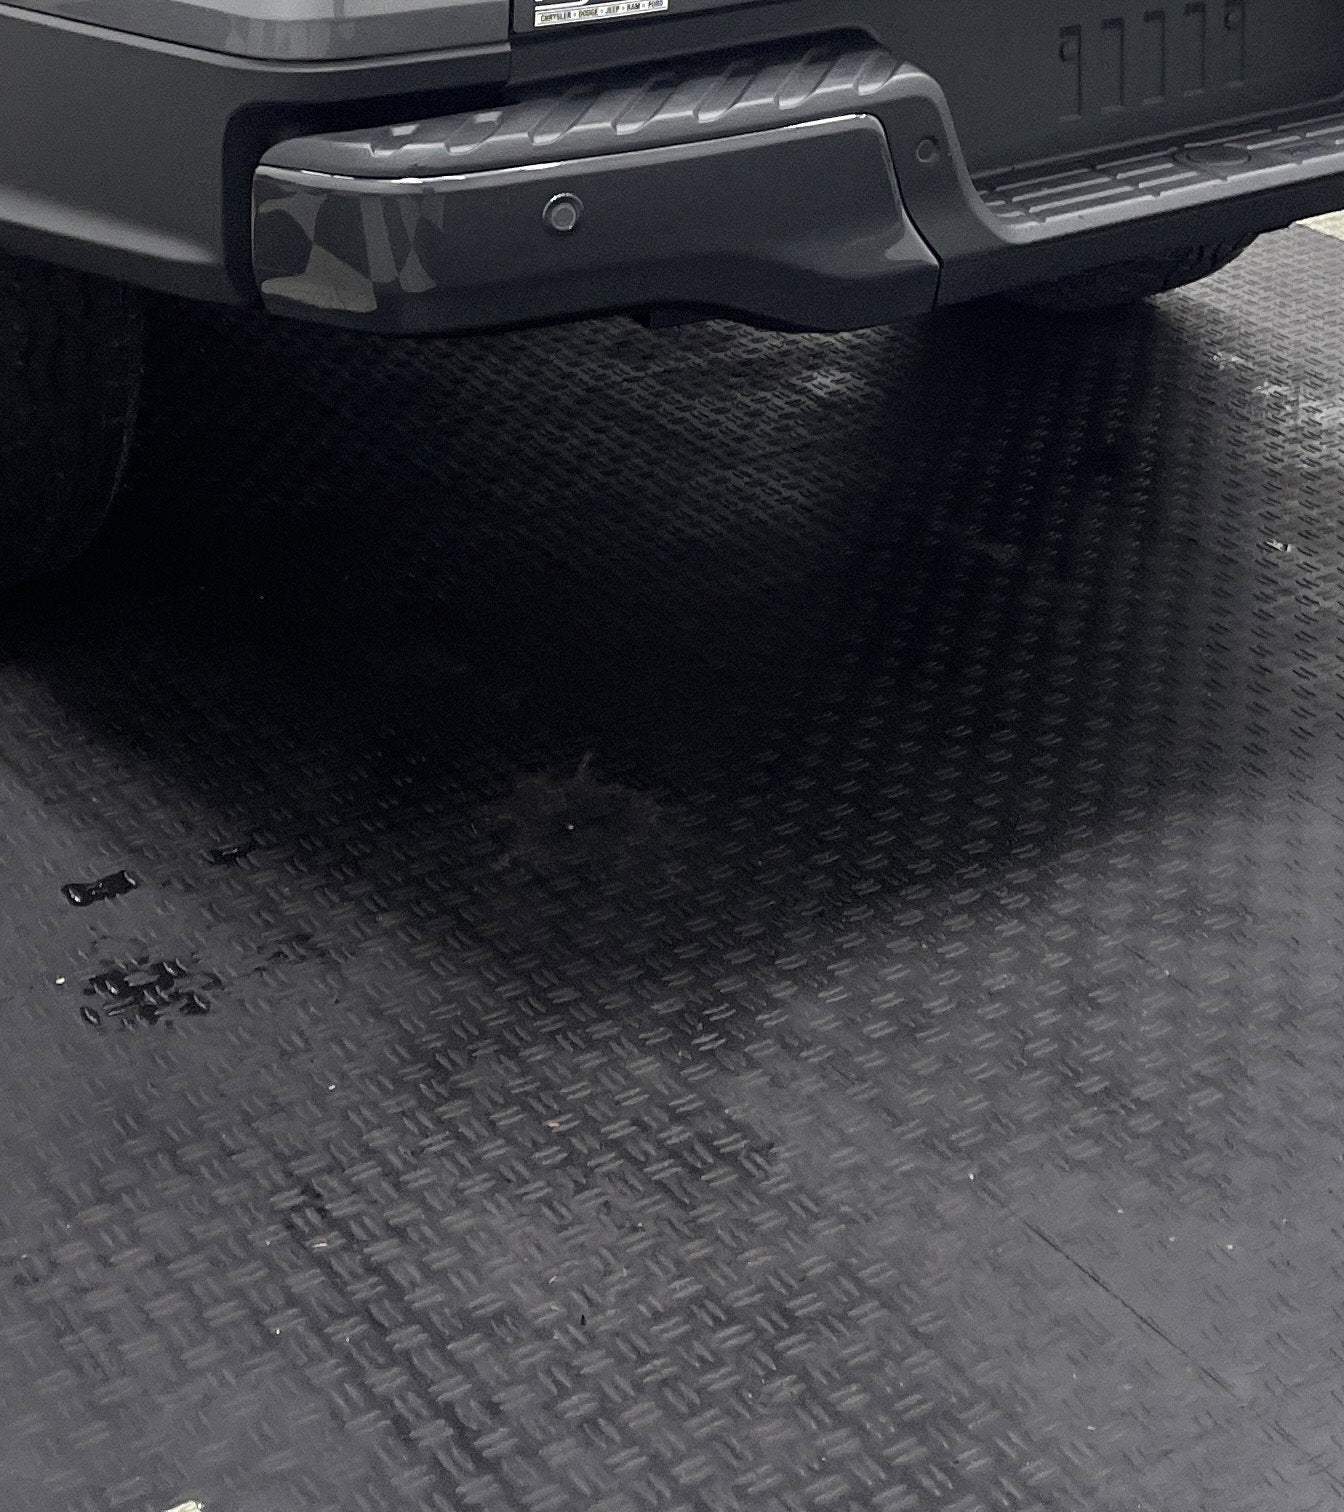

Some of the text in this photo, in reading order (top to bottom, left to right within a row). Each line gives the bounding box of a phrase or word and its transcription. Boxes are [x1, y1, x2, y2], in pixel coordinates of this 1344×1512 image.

[540, 11, 571, 22] CHRYSLER
[578, 8, 598, 18] DODGE
[605, 5, 620, 14] JEEP
[626, 3, 641, 12] RAM
